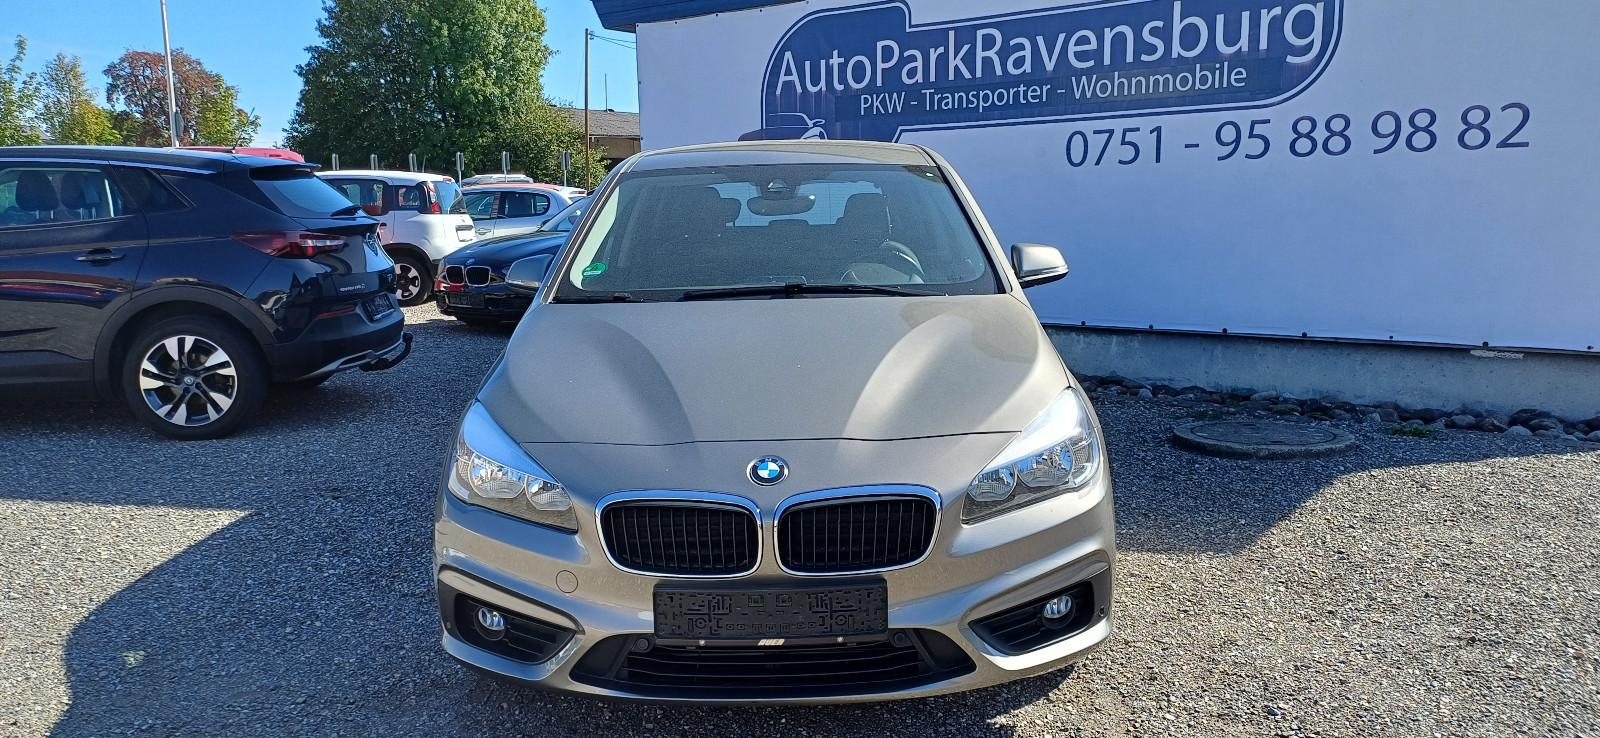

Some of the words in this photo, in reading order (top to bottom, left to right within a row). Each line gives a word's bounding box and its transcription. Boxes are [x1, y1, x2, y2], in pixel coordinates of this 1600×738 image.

[775, 1, 1325, 95] AutoParkRavensburg
[860, 92, 905, 115] PKW
[921, 83, 1051, 112] Transporter
[1071, 62, 1247, 99] Wohnmobile
[1065, 125, 1163, 168] 0751
[1214, 118, 1272, 161] 95
[1288, 113, 1352, 158] 88
[1370, 108, 1437, 154] 98
[1456, 102, 1531, 151] 82
